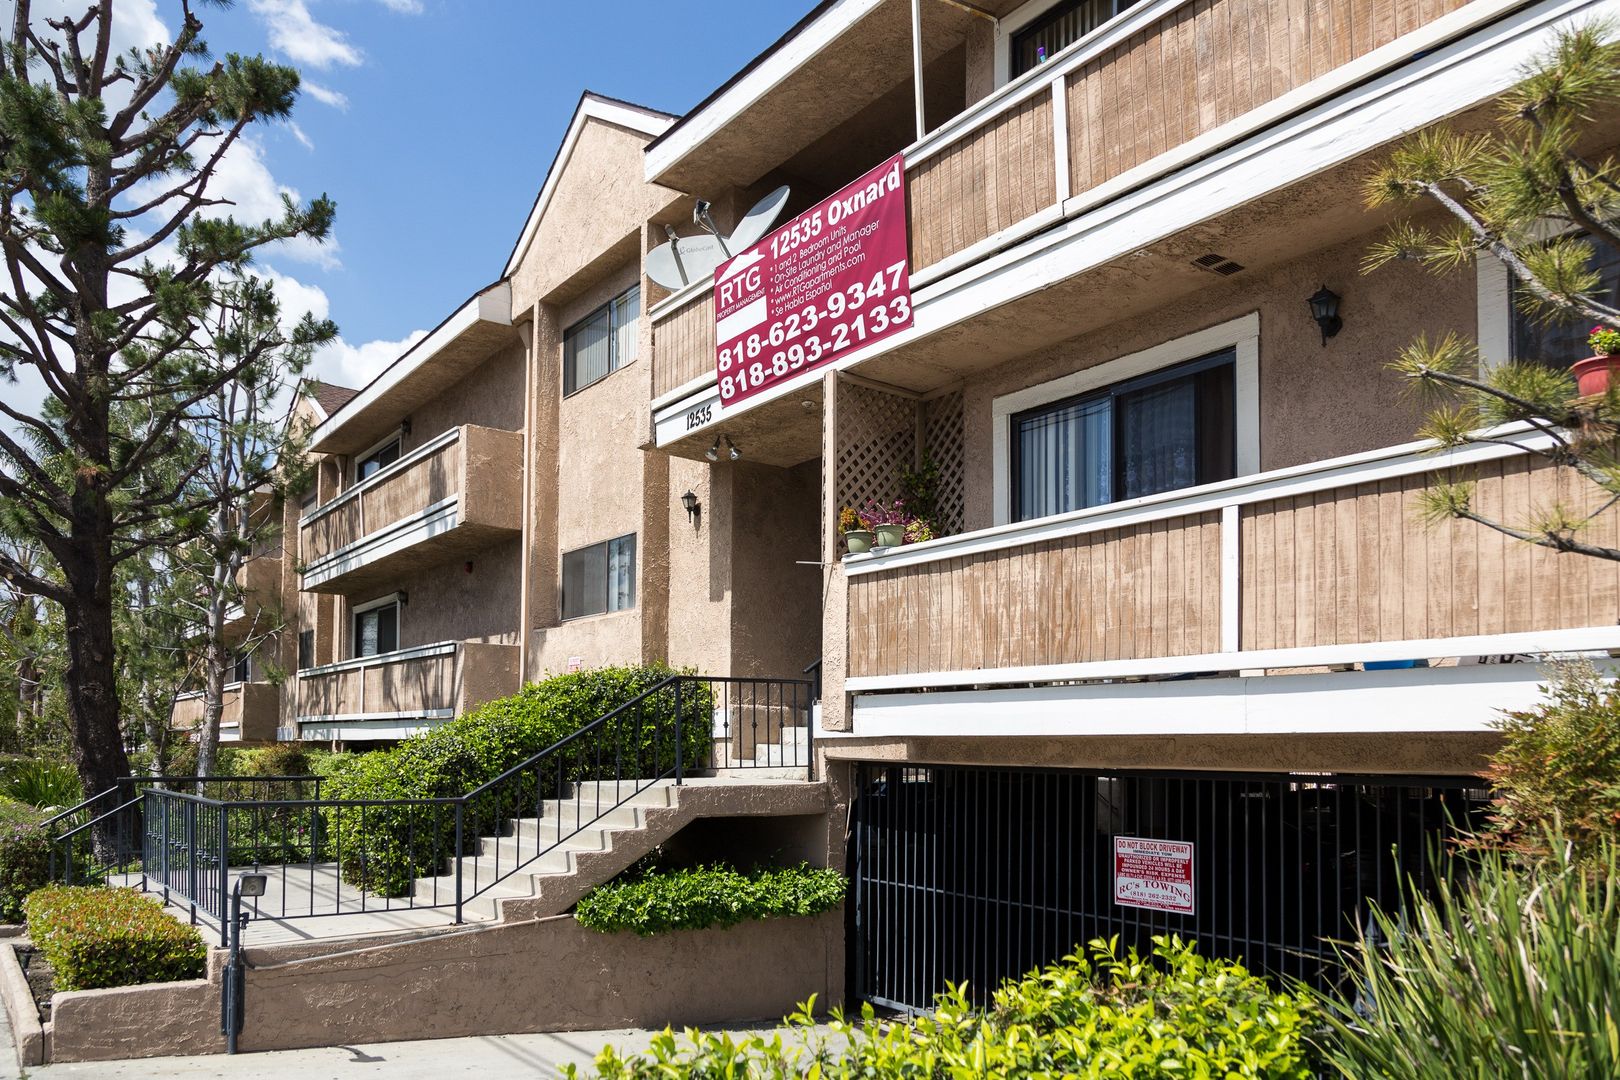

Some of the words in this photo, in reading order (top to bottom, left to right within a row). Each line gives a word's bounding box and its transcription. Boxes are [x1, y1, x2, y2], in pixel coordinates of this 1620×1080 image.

[770, 212, 822, 259] 12535
[827, 162, 901, 226] Oxnard
[774, 264, 798, 284] On-Site
[798, 249, 826, 271] Laundry
[826, 239, 842, 254] and
[842, 220, 880, 247] Manager
[774, 280, 783, 295] Air
[784, 263, 827, 289] Conditioning
[827, 251, 843, 266] and
[843, 240, 862, 257] Pool
[778, 253, 792, 271] and
[792, 253, 797, 263] 2
[799, 237, 830, 259] Bedroom
[830, 226, 847, 240] Units
[720, 266, 761, 309] RTG
[774, 252, 866, 305] www.RTGapartments.com
[775, 306, 784, 317] Se
[784, 296, 805, 312] Habla
[805, 279, 833, 301] Español
[717, 306, 736, 320] PROPERTY
[735, 287, 766, 309] MANAGEMENT
[718, 260, 906, 373] 818-623-9347
[720, 296, 911, 399] 818-893-2133
[686, 404, 712, 431] 12535
[1128, 841, 1138, 849] NOT
[1140, 842, 1158, 851] BLOCK
[1160, 844, 1188, 854] DRIVEWAY
[1120, 882, 1139, 893] RC's
[1143, 881, 1190, 902] TOWING
[1149, 893, 1176, 902] 262-2332
